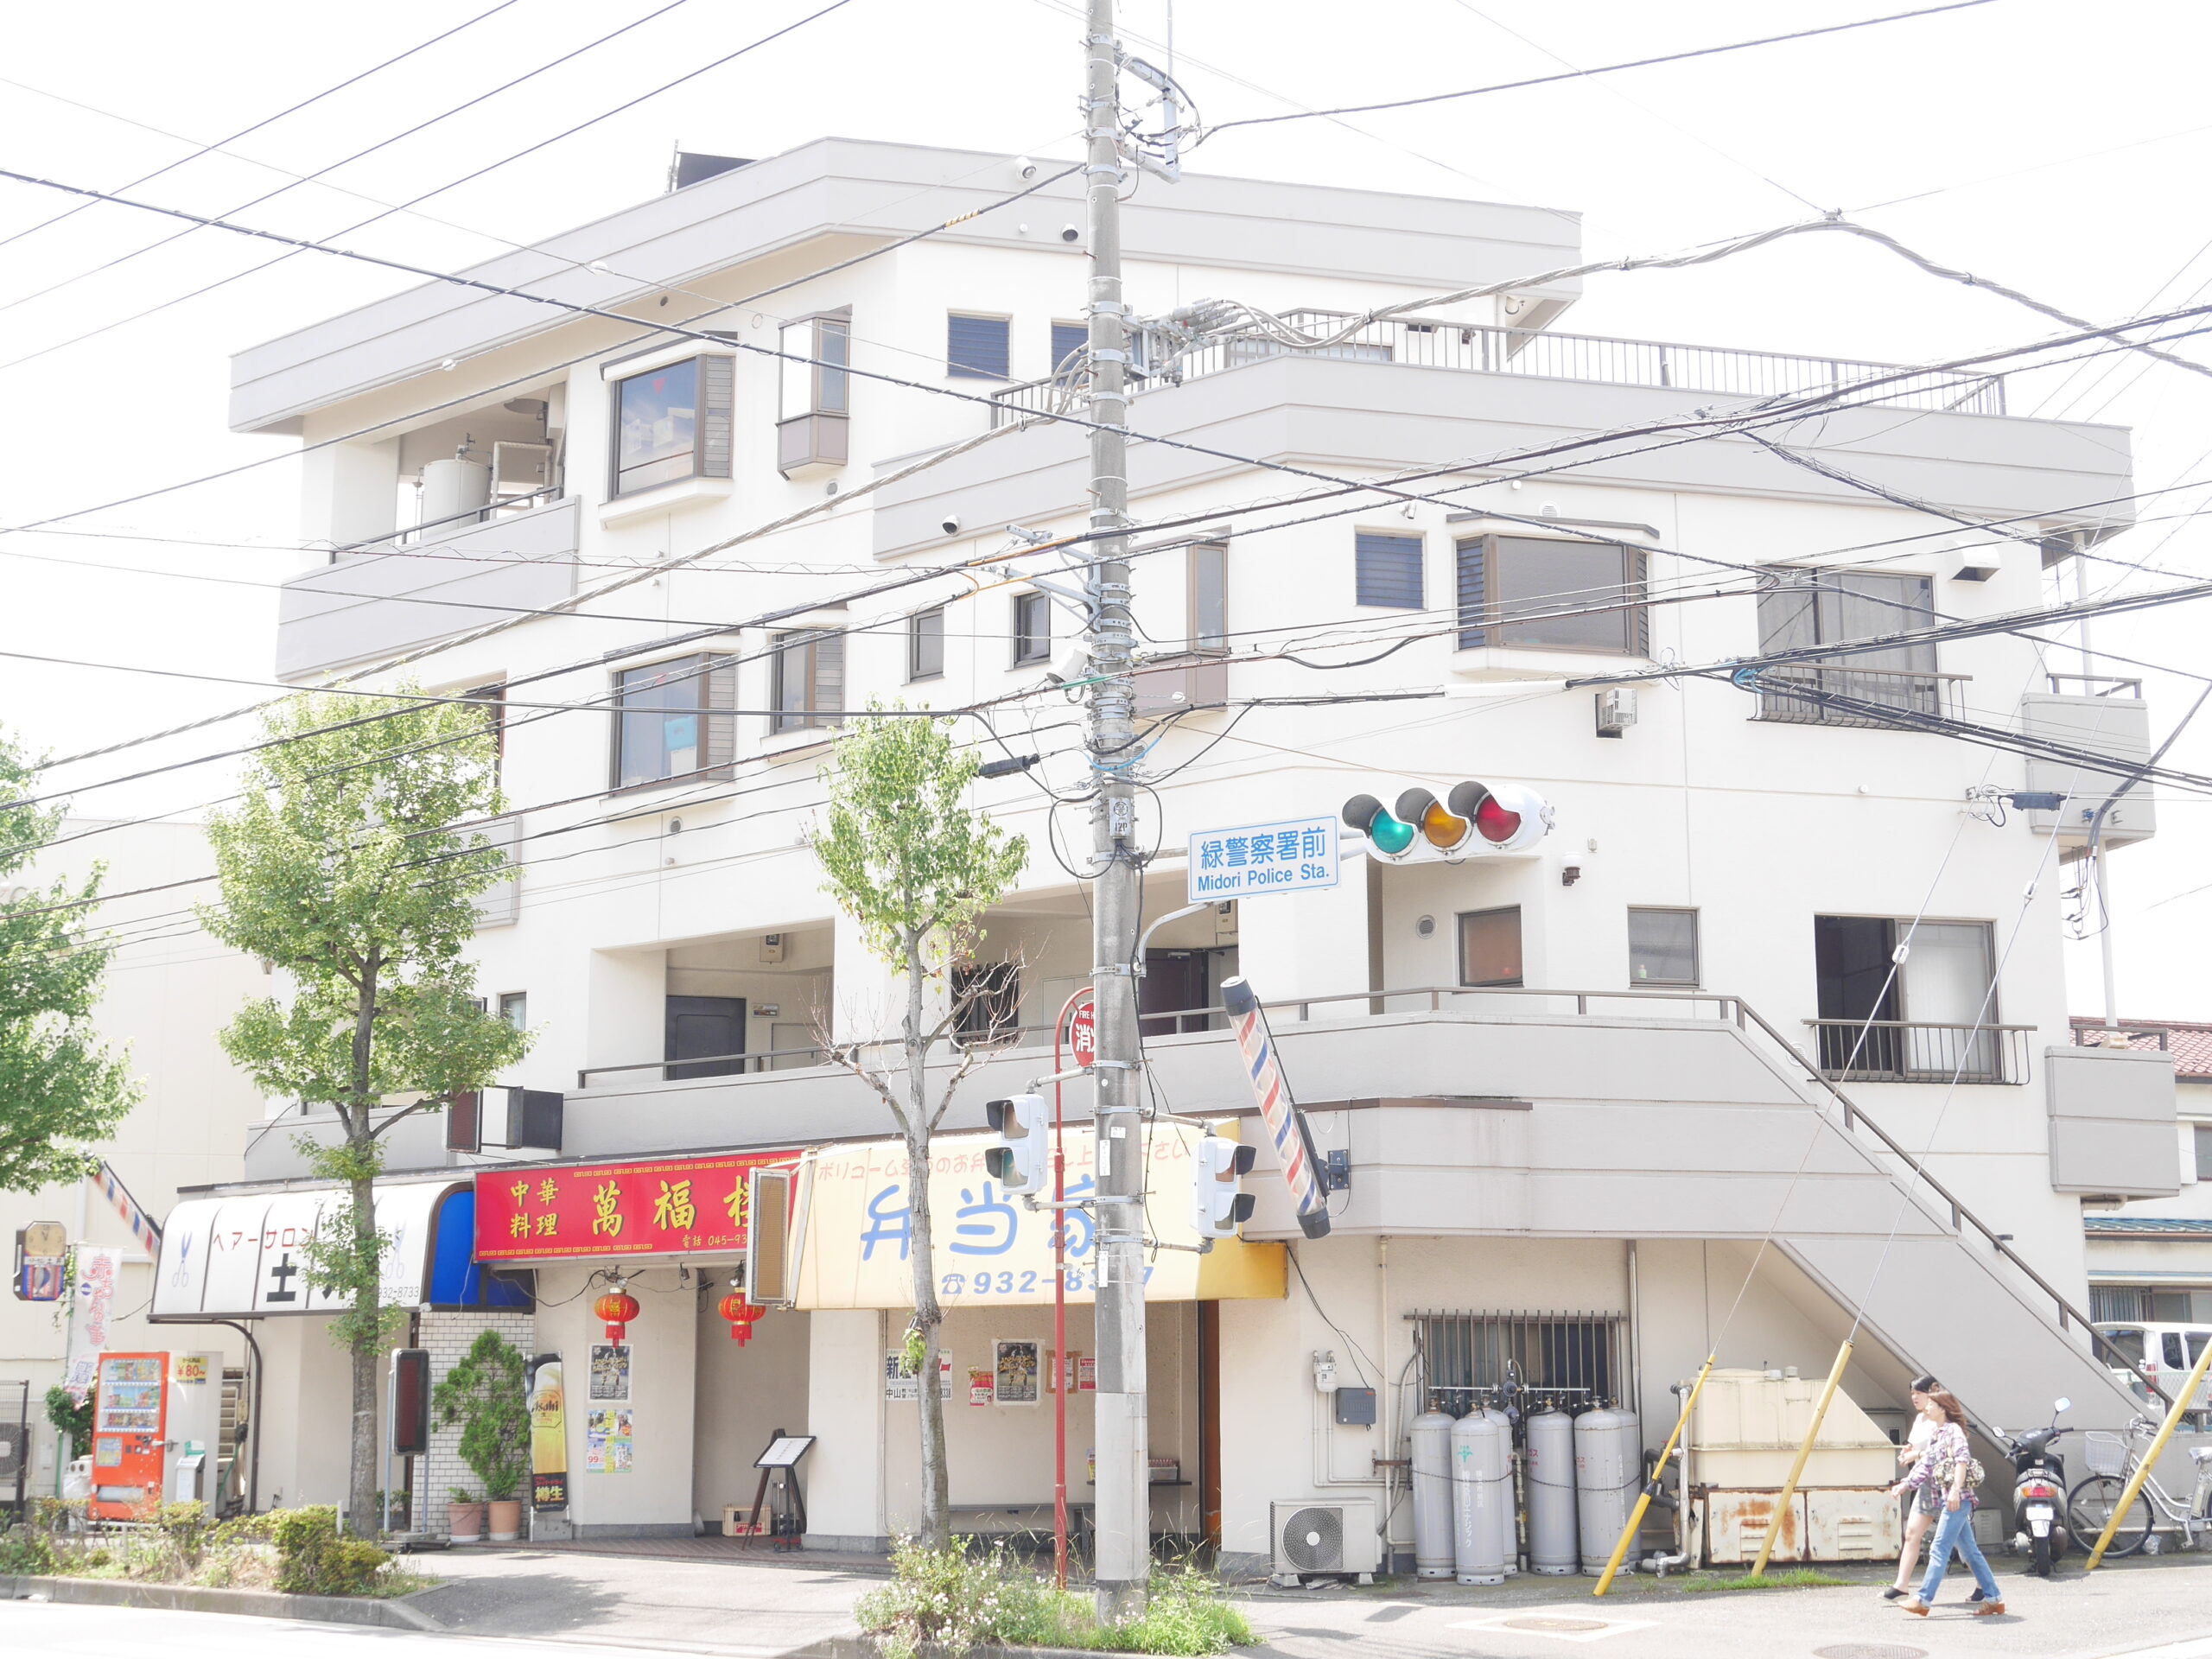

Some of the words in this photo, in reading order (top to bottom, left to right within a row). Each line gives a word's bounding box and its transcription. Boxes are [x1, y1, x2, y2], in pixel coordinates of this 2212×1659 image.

[1201, 826, 1326, 870] 緑警察署前
[1198, 872, 1241, 892] Midori
[1248, 868, 1294, 886] Police
[1300, 863, 1330, 880] Sta.
[1078, 1011, 1090, 1020] FIRE
[511, 1177, 560, 1208] 中華
[511, 1213, 560, 1239] 料理
[683, 1234, 702, 1249] 電話
[708, 1234, 747, 1246] 045-93
[886, 1388, 901, 1399] 中山
[531, 1400, 559, 1413] Asahi
